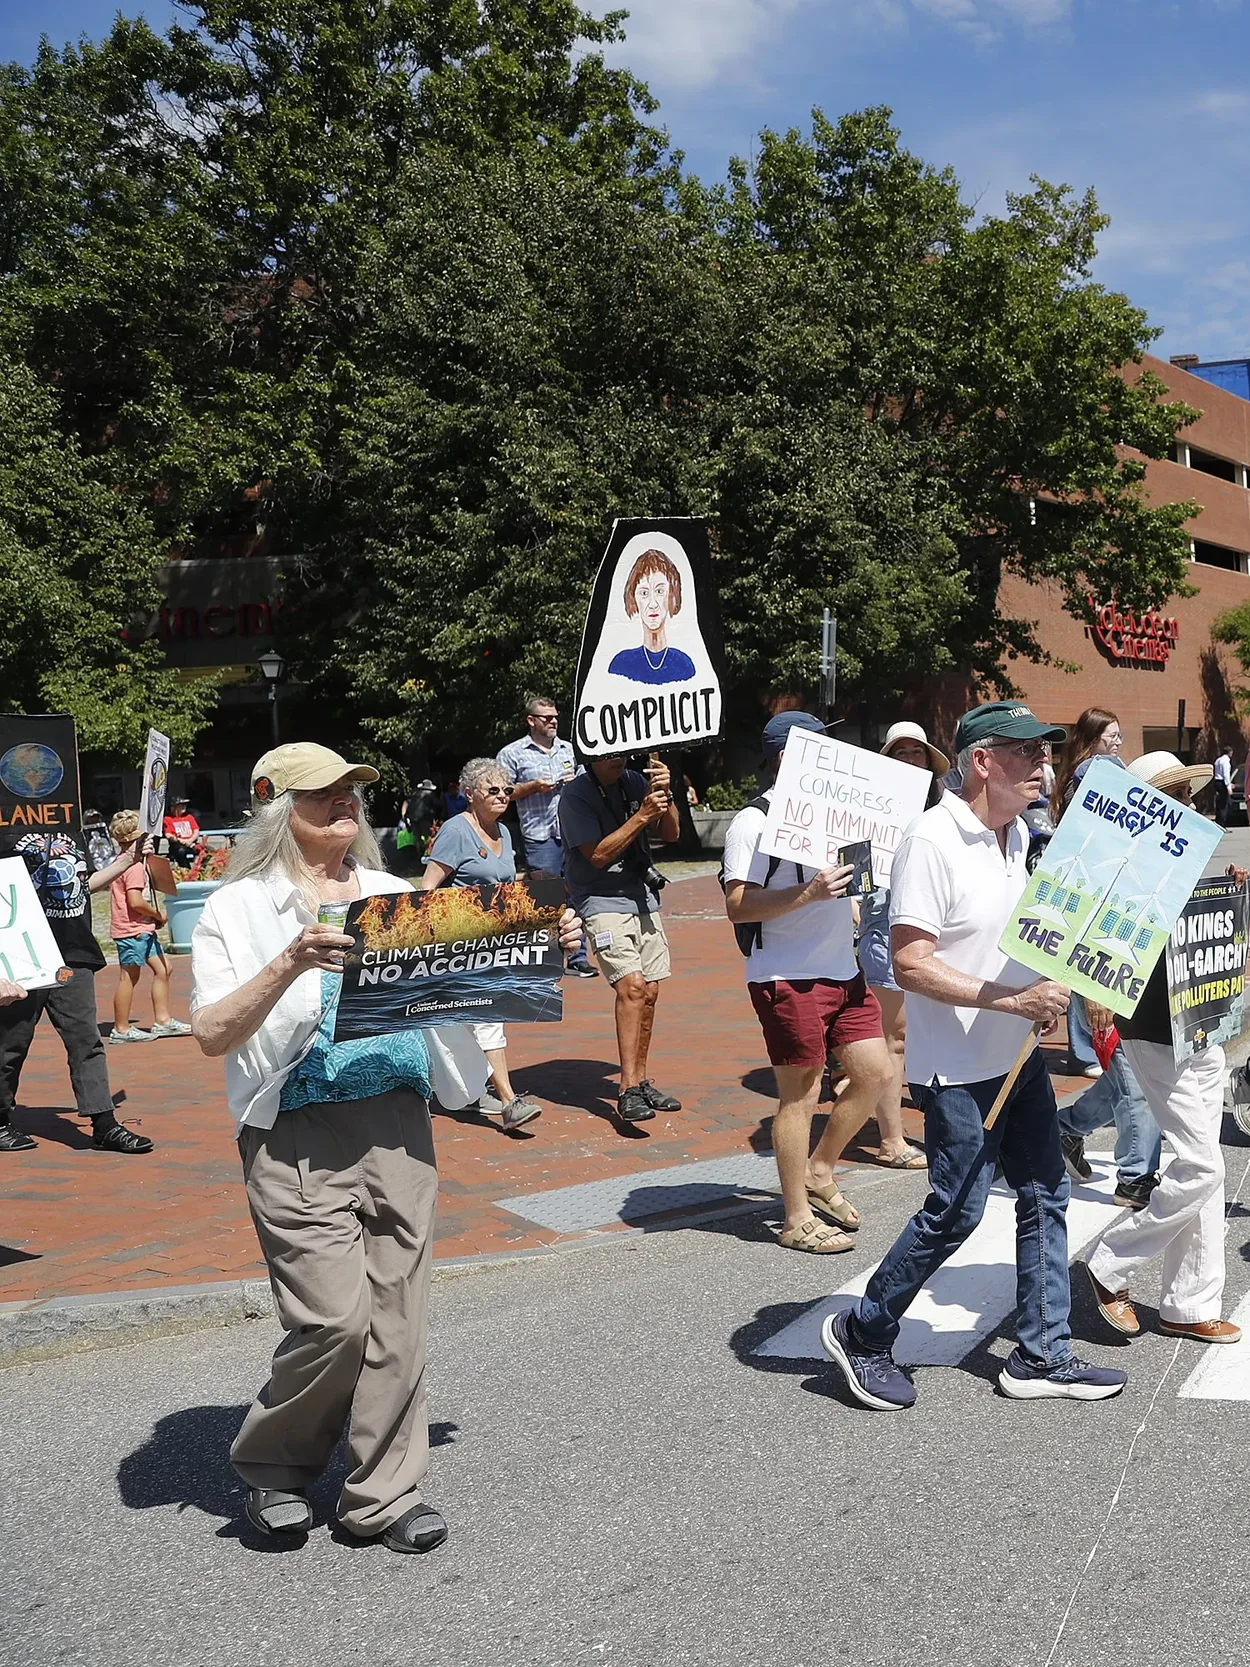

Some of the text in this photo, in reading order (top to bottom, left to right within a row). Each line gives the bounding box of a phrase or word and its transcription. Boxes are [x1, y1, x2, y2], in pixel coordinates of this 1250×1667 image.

[578, 688, 715, 748] COMPLICIT
[796, 735, 870, 782] TELL
[784, 798, 814, 828] NO
[1082, 789, 1189, 857] ENERGY IS
[1126, 786, 1184, 830] CLEAN
[774, 829, 813, 857] FOR
[871, 853, 891, 876] IL
[1208, 886, 1227, 895] PEOPLE
[1018, 917, 1065, 957] THE
[1188, 909, 1234, 944] KINGS
[358, 945, 549, 987] NO ACCIDENT
[361, 929, 549, 966] CLIMATE CHANGE IS
[411, 998, 493, 1013] Concerned Scientists
[1182, 979, 1230, 1011] POLLUTERS
